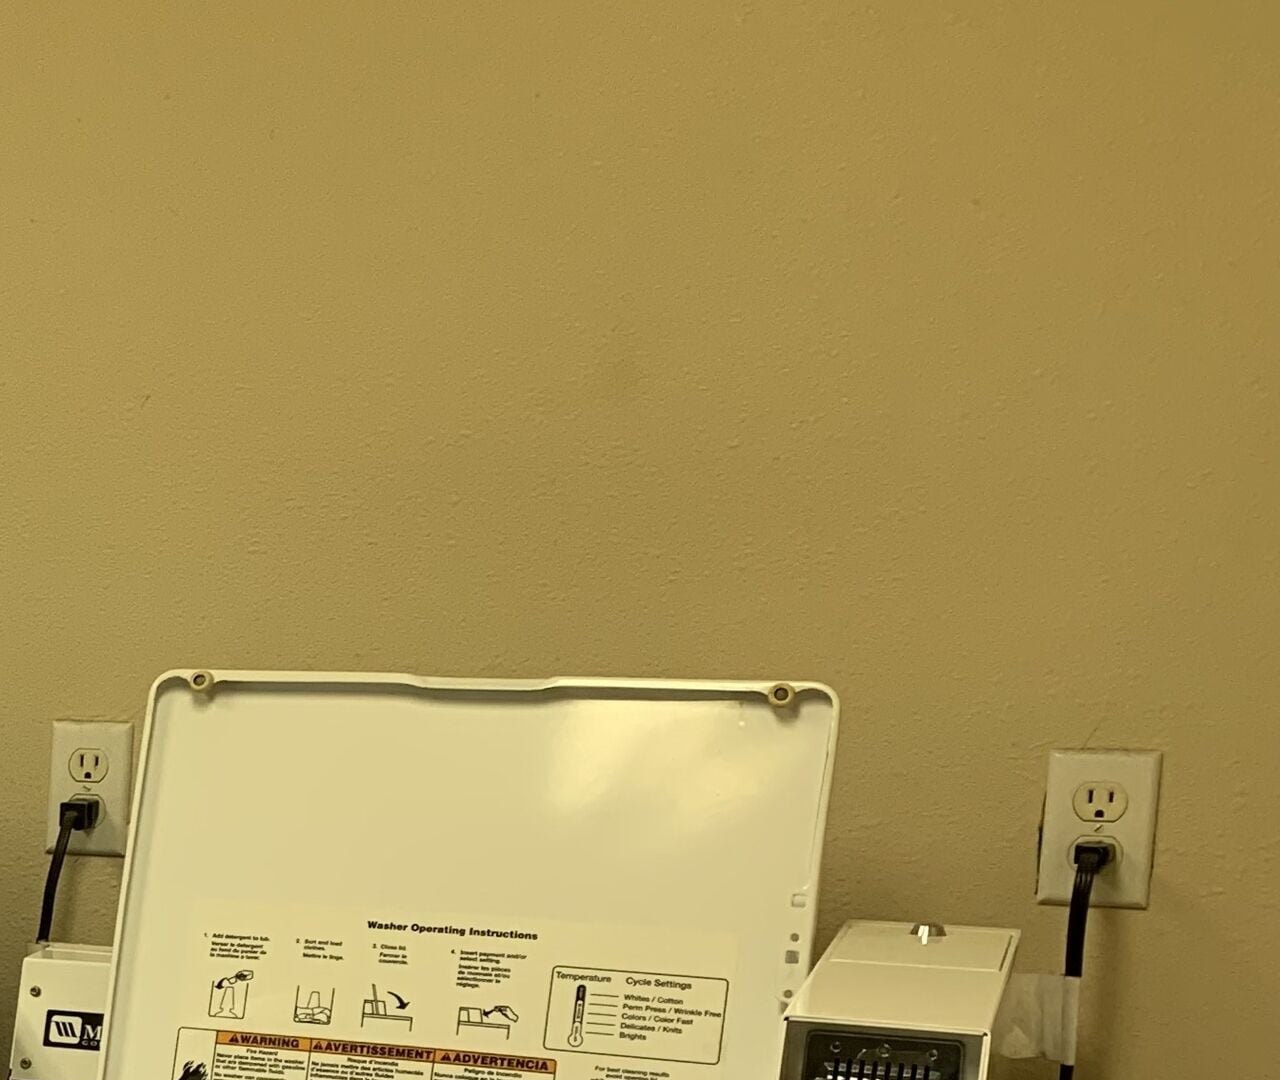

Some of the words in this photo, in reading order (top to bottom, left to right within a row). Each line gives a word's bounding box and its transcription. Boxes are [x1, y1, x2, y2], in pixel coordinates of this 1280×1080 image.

[367, 922, 408, 932] Washer
[411, 925, 466, 938] Operating
[469, 928, 538, 940] Instructions
[556, 972, 612, 984] Temperature
[625, 978, 652, 988] Cycle
[654, 980, 692, 991] Settings
[620, 1024, 656, 1032] Delicates
[240, 1035, 299, 1048] WARNING
[619, 1033, 647, 1042] Brights
[325, 1042, 433, 1060] AVERTISSEMENT
[452, 1053, 548, 1071] ADVERTENCIA
